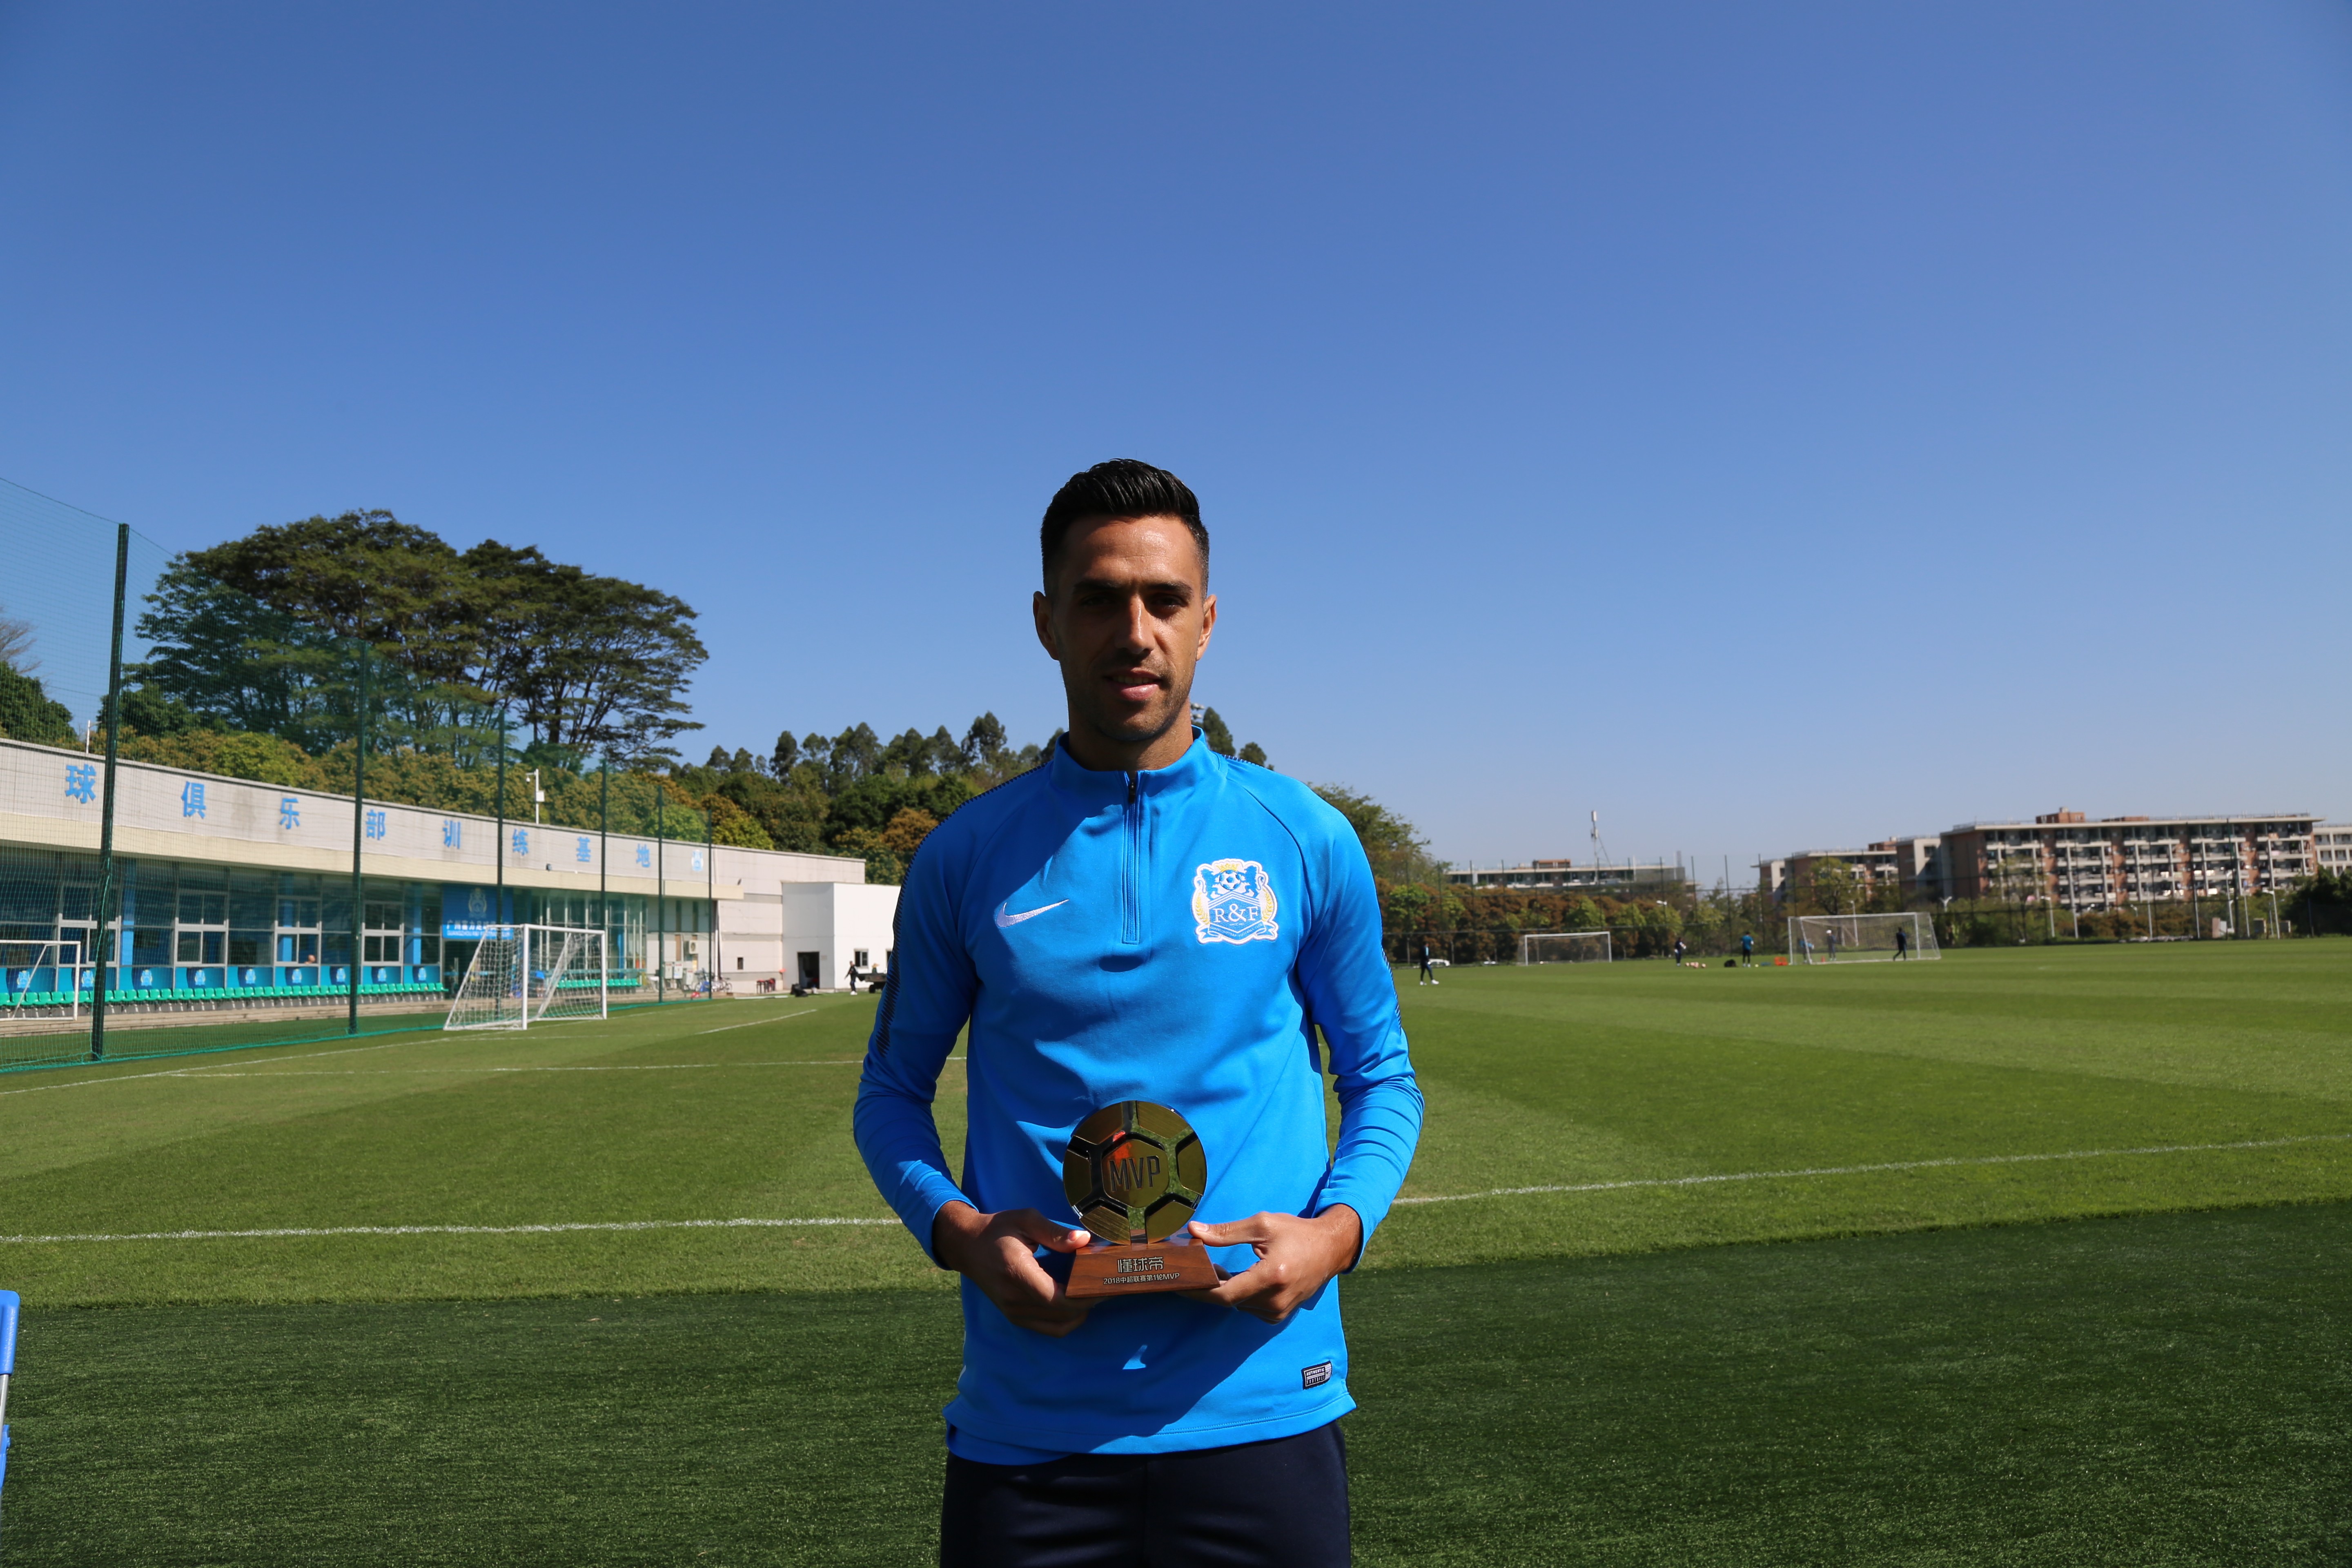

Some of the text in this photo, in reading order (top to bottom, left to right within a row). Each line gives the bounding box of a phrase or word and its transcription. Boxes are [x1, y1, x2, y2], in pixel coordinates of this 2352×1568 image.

[1212, 903, 1258, 922] R&F
[1109, 1155, 1160, 1192] MVP
[1117, 1256, 1163, 1273] 懂球帝
[1103, 1272, 1180, 1285] 2018中超联赛第1轮MVP
[1307, 1375, 1325, 1384] FOOTBALL
